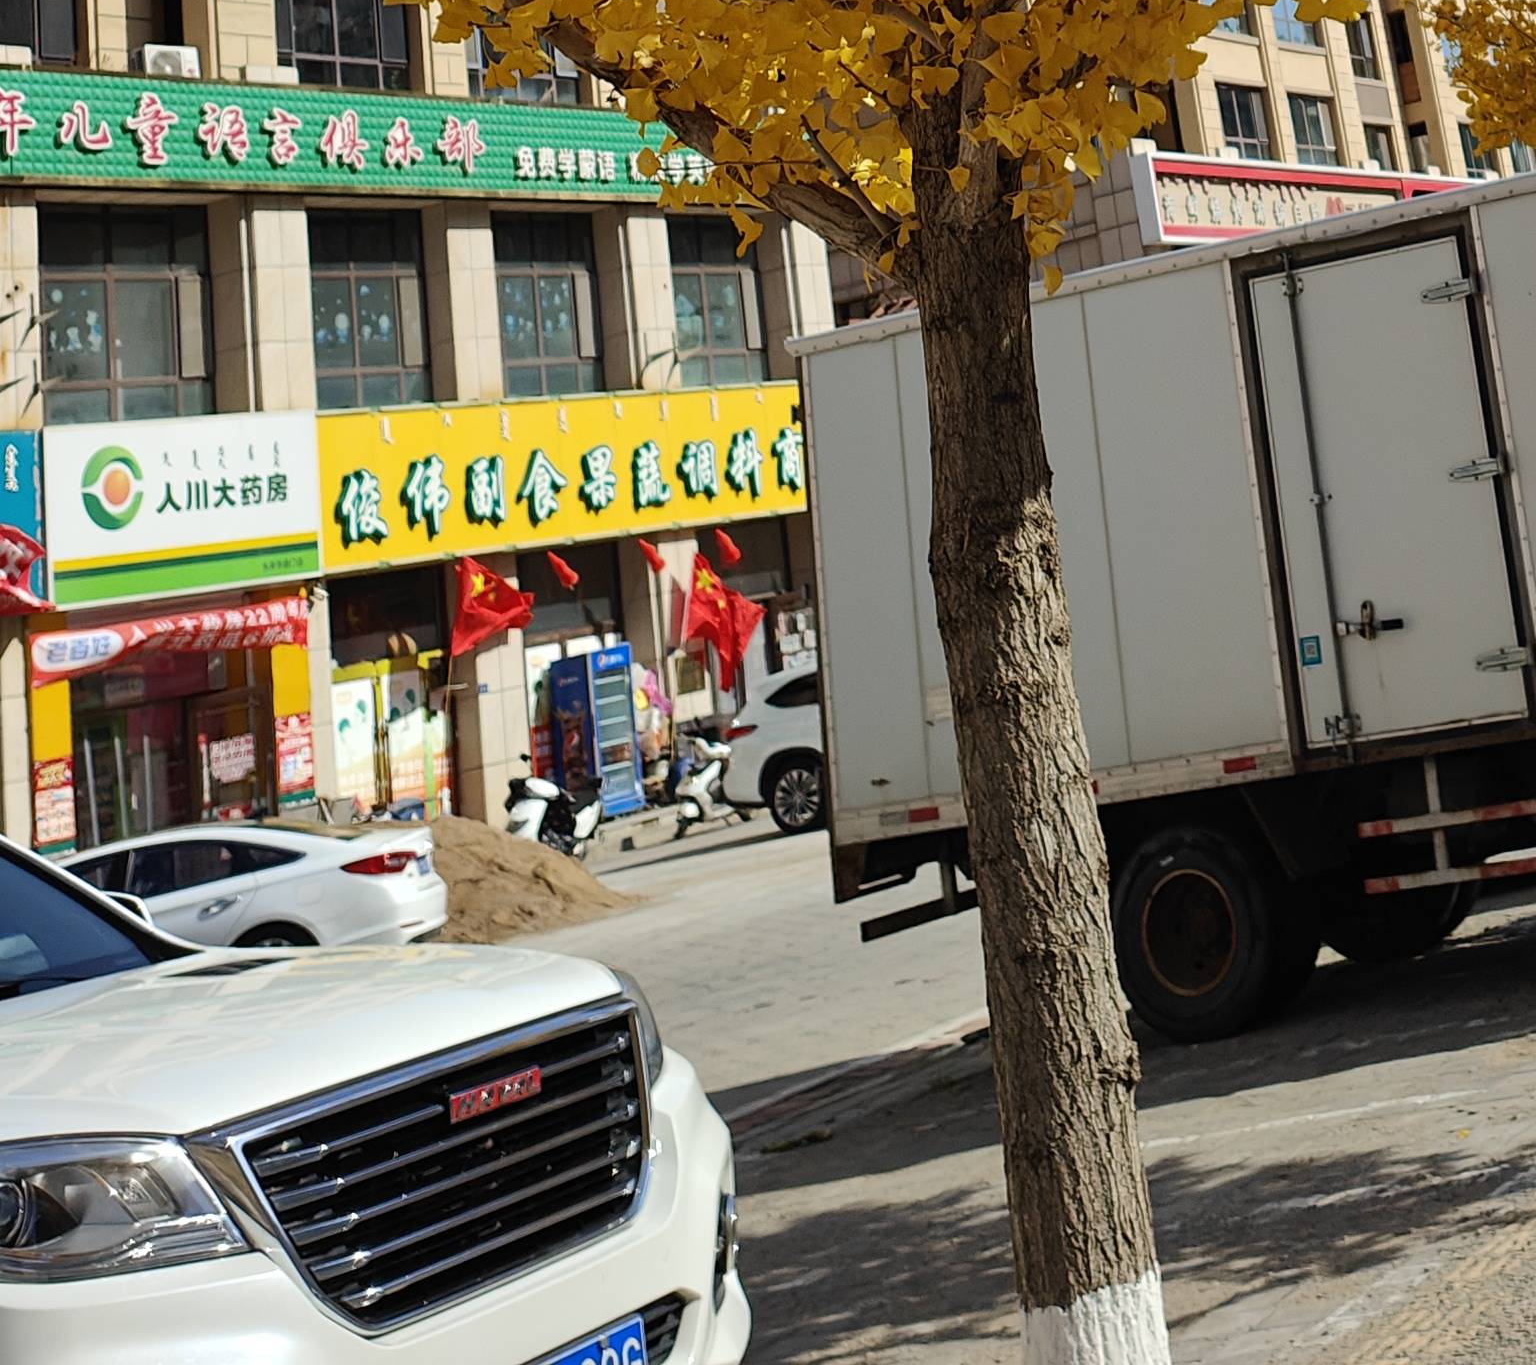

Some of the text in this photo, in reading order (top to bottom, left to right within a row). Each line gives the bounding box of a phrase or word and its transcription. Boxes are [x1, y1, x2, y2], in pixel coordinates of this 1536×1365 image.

[516, 146, 616, 182] 免费学蒙语
[157, 473, 287, 513] 人川大药房
